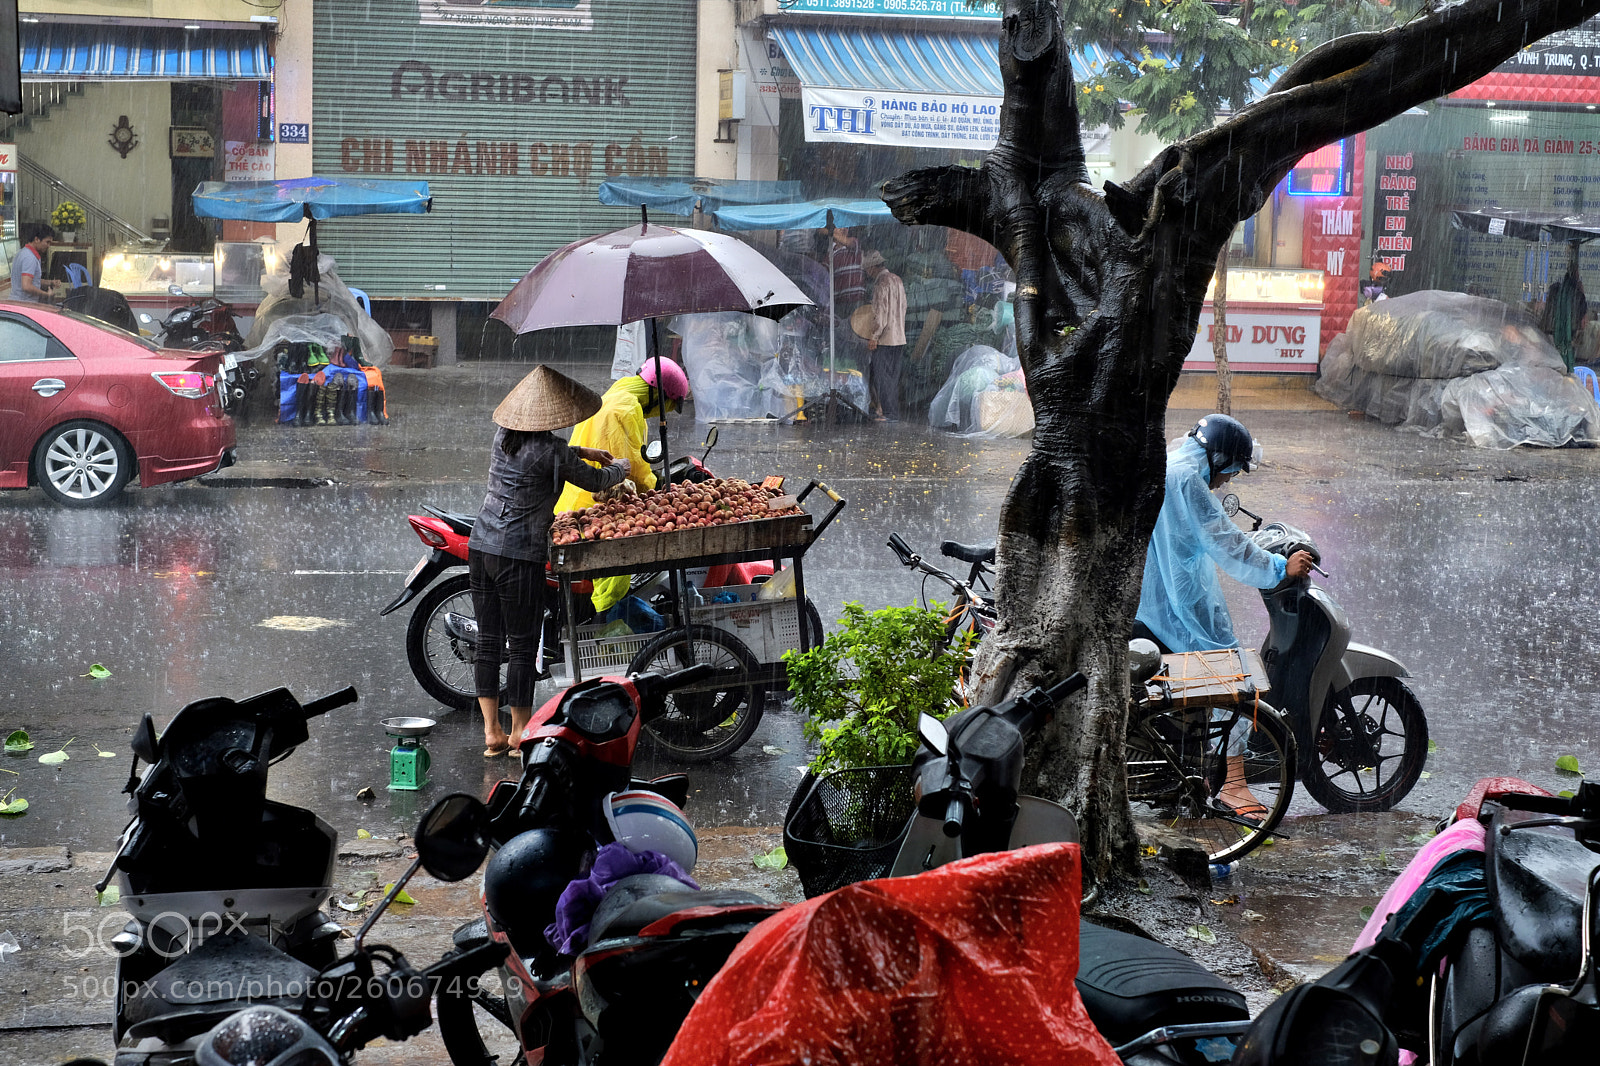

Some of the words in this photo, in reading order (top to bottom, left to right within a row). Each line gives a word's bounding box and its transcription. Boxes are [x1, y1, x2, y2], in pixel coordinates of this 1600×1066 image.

[883, 0, 947, 12] 0905.526.781
[1544, 53, 1576, 70] TRUNG,
[391, 59, 630, 106] AGRIBANK
[881, 99, 918, 112] HÀNG
[921, 99, 948, 113] BẢO
[951, 101, 969, 117] HỘ
[972, 104, 996, 116] LAO
[281, 124, 307, 138] 334
[1464, 132, 1496, 152] BẢNG
[1500, 135, 1520, 152] GIÁ
[1544, 135, 1575, 154] GIẢM
[341, 137, 393, 173] CHI
[405, 131, 518, 175] NHÁNH
[1380, 173, 1417, 191] RĂNG
[1385, 192, 1410, 211] TRẺ
[1385, 216, 1407, 231] EM
[1176, 995, 1240, 1006] HONDA
